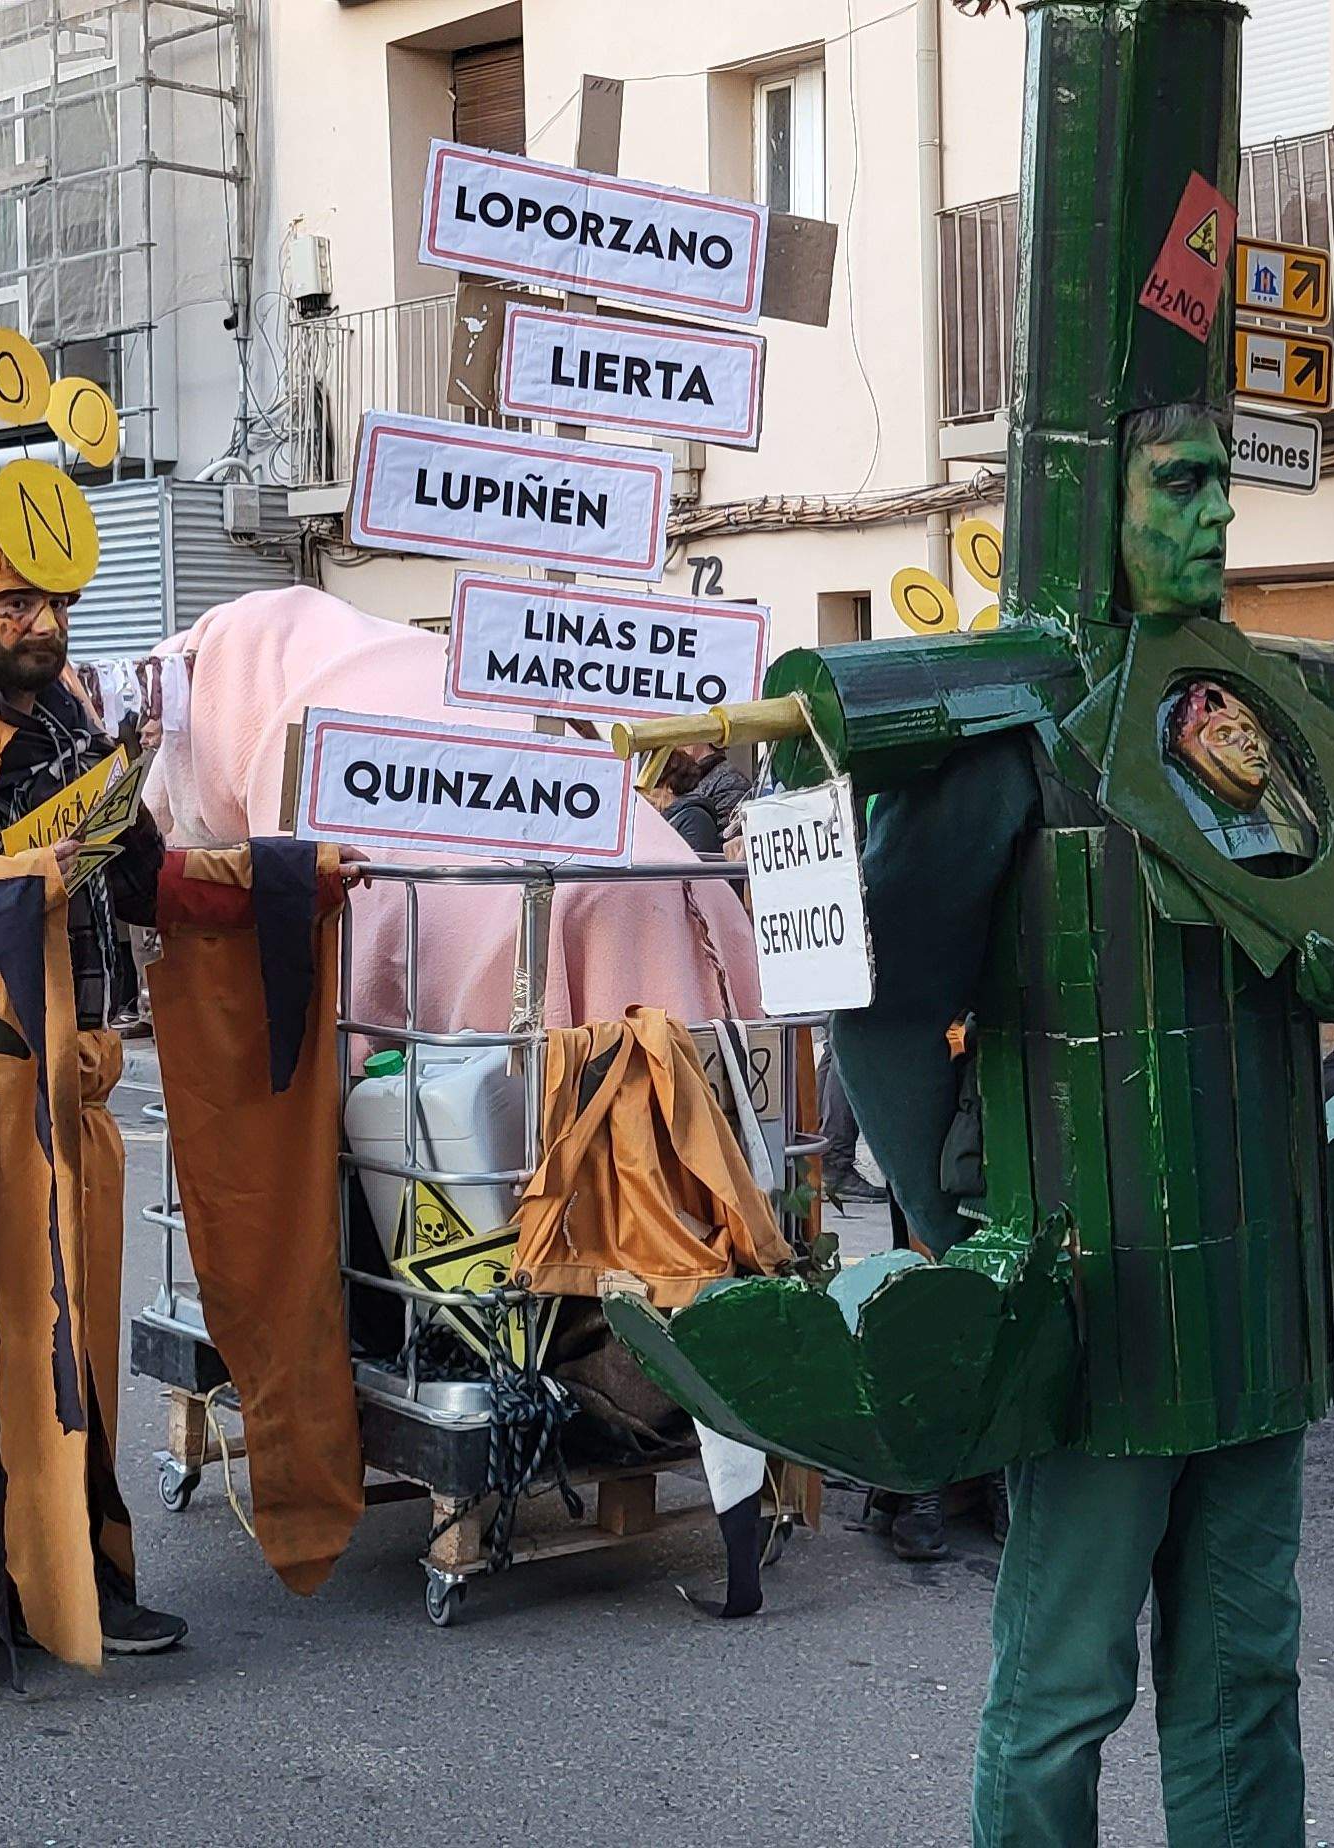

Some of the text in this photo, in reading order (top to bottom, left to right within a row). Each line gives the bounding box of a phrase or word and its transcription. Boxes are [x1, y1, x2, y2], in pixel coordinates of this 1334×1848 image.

[455, 185, 733, 270] LOPORZANO
[551, 346, 714, 406] LIERTA
[19, 482, 72, 561] N
[415, 468, 608, 530] LUPIÑÉN
[687, 556, 723, 596] 72
[649, 624, 698, 659] DE
[486, 650, 727, 705] MARCUELLO
[343, 760, 601, 819] QUINZANO
[750, 820, 843, 876] FUERA DE
[760, 903, 844, 956] SERVICIO
